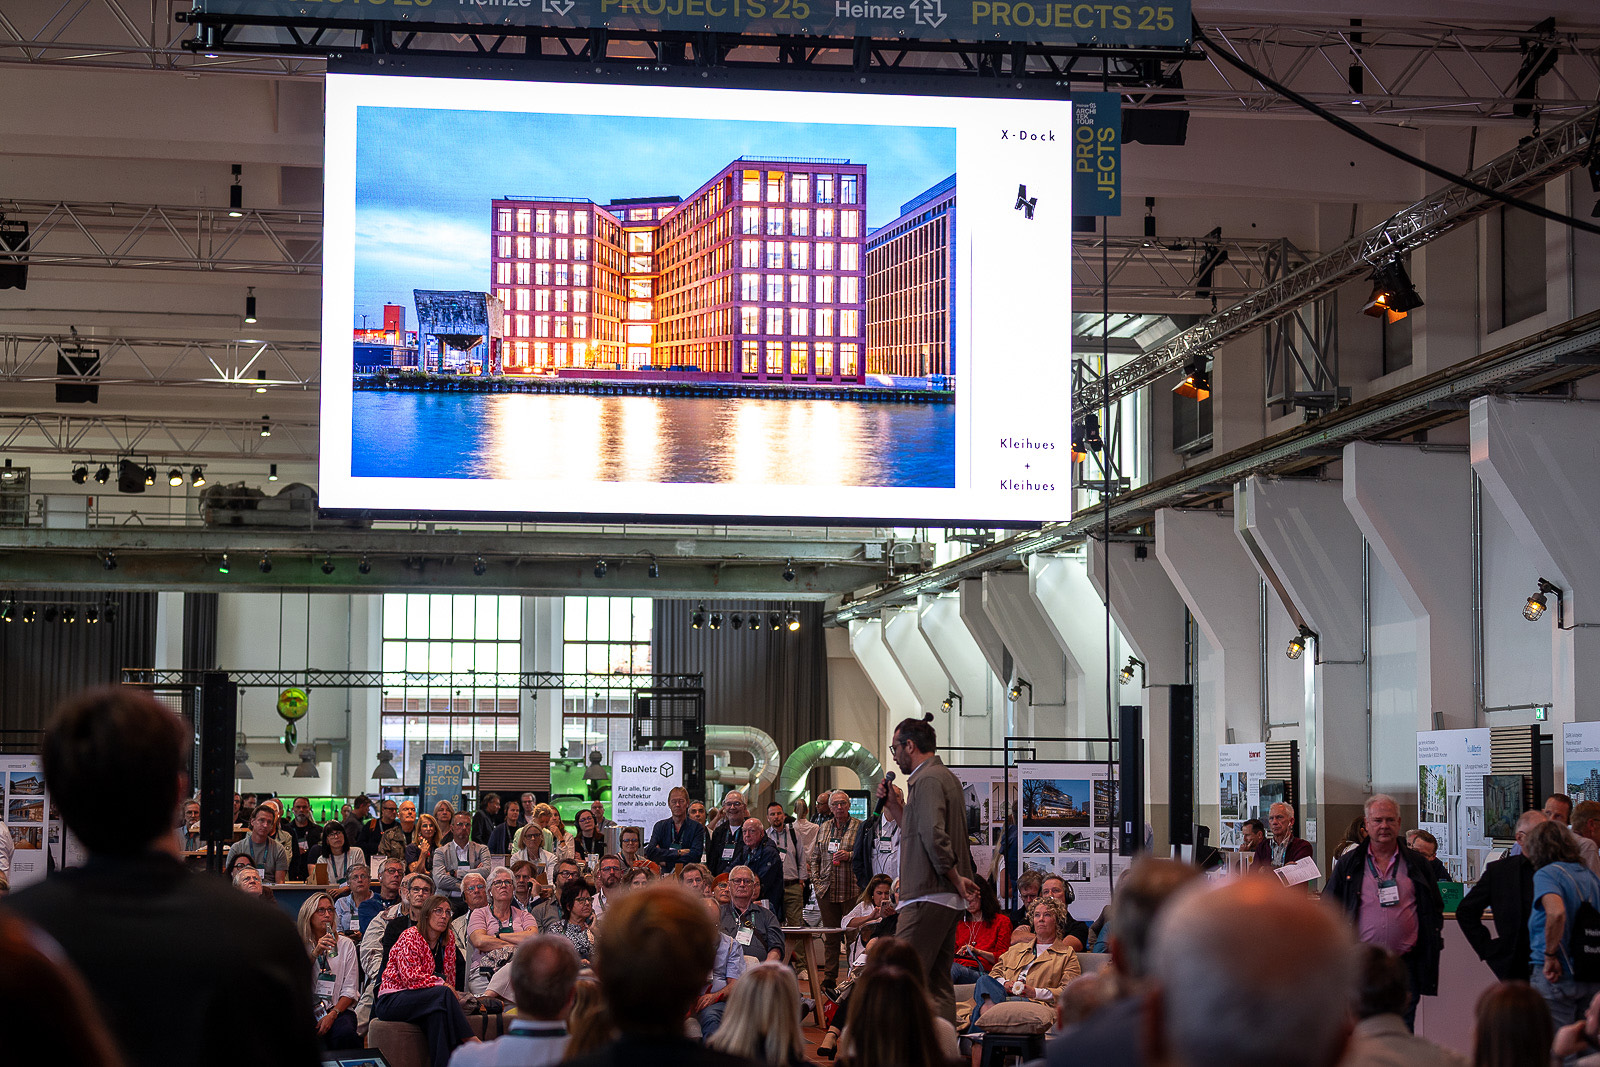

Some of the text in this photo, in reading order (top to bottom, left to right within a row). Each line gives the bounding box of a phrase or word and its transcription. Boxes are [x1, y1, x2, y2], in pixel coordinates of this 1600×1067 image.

[772, 0, 810, 19] 25
[835, 0, 906, 19] Heinze
[972, 1, 1174, 31] PROJECTS 25
[1001, 129, 1056, 141] X-Dock
[1076, 126, 1094, 172] PRO
[1097, 127, 1115, 199] JECTS
[1000, 437, 1055, 449] Kleihues
[1000, 479, 1055, 491] Kleihues
[437, 765, 460, 775] PRO
[621, 765, 657, 773] BauNetz
[425, 776, 459, 785] JECTS
[425, 786, 438, 796] 25
